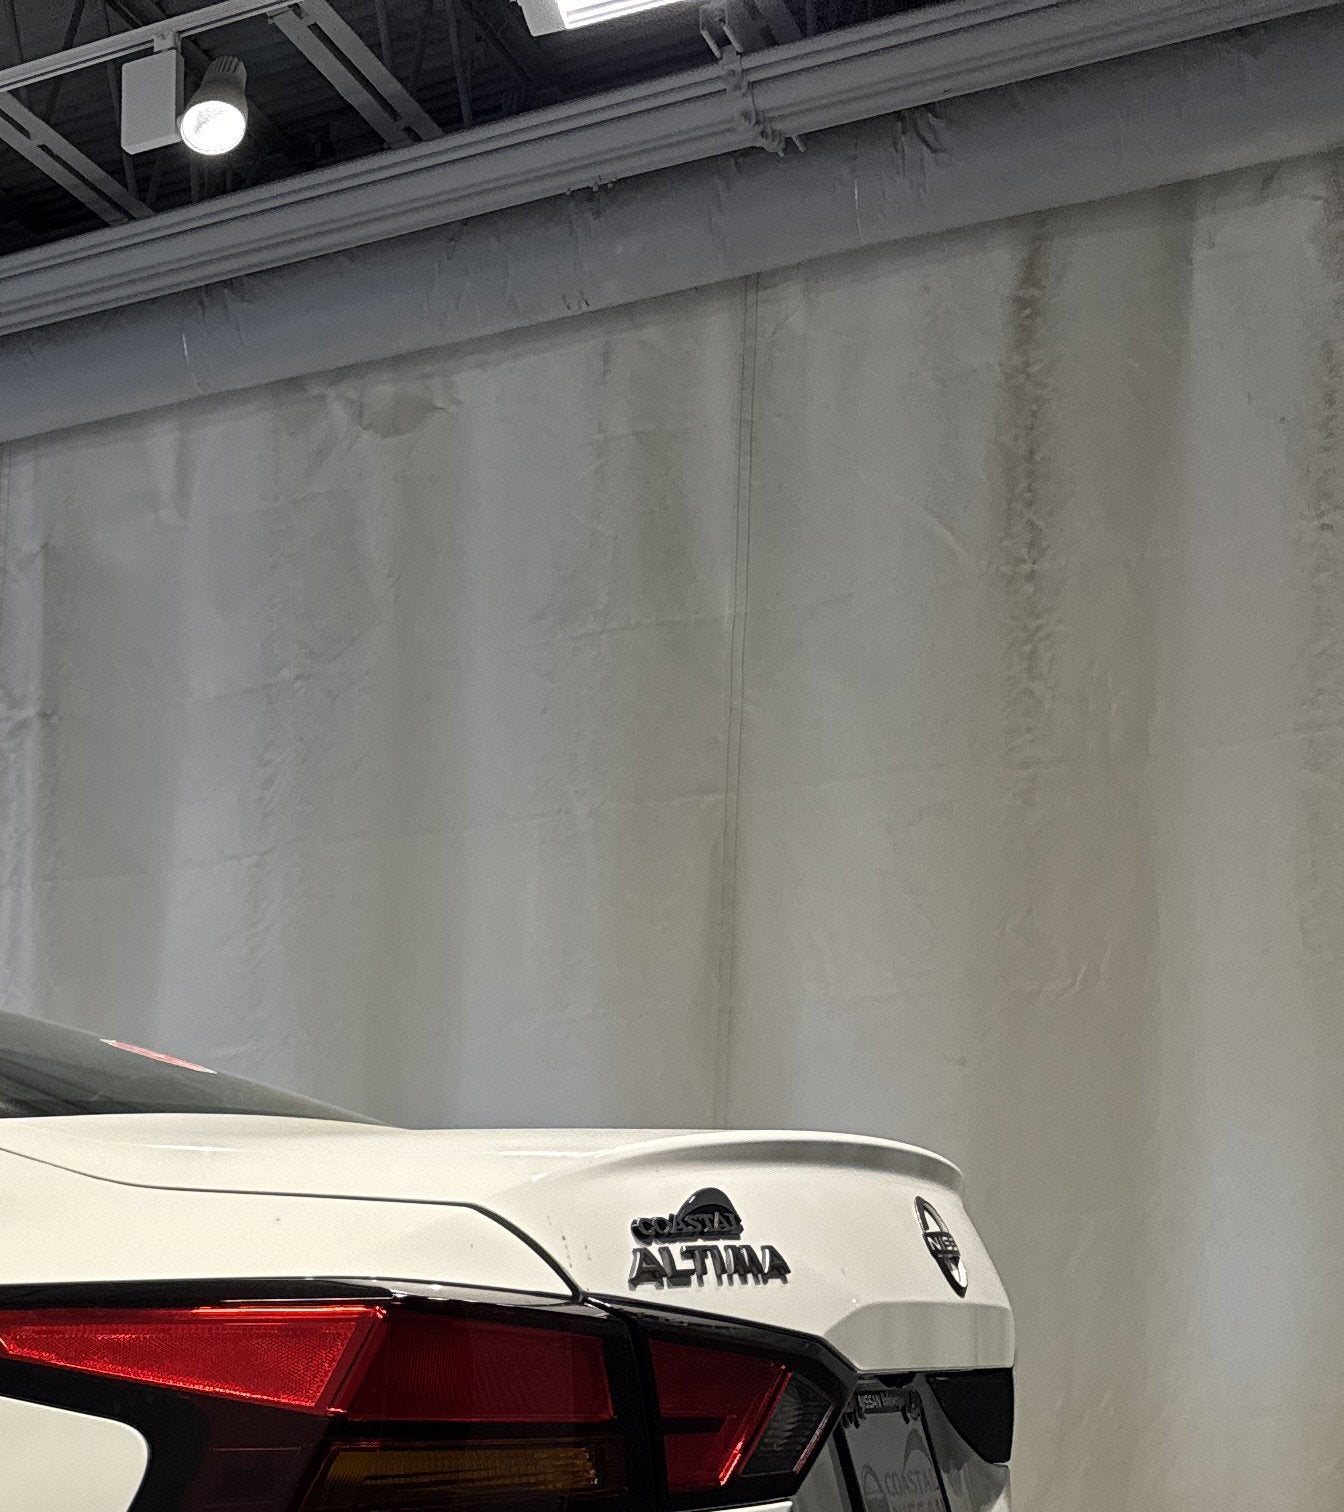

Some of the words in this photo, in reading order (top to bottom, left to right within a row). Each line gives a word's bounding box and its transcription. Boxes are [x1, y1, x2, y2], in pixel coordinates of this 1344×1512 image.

[632, 1211, 742, 1242] COASTAL
[628, 1244, 792, 1286] ALTIMA
[884, 1469, 942, 1499] COASTAL
